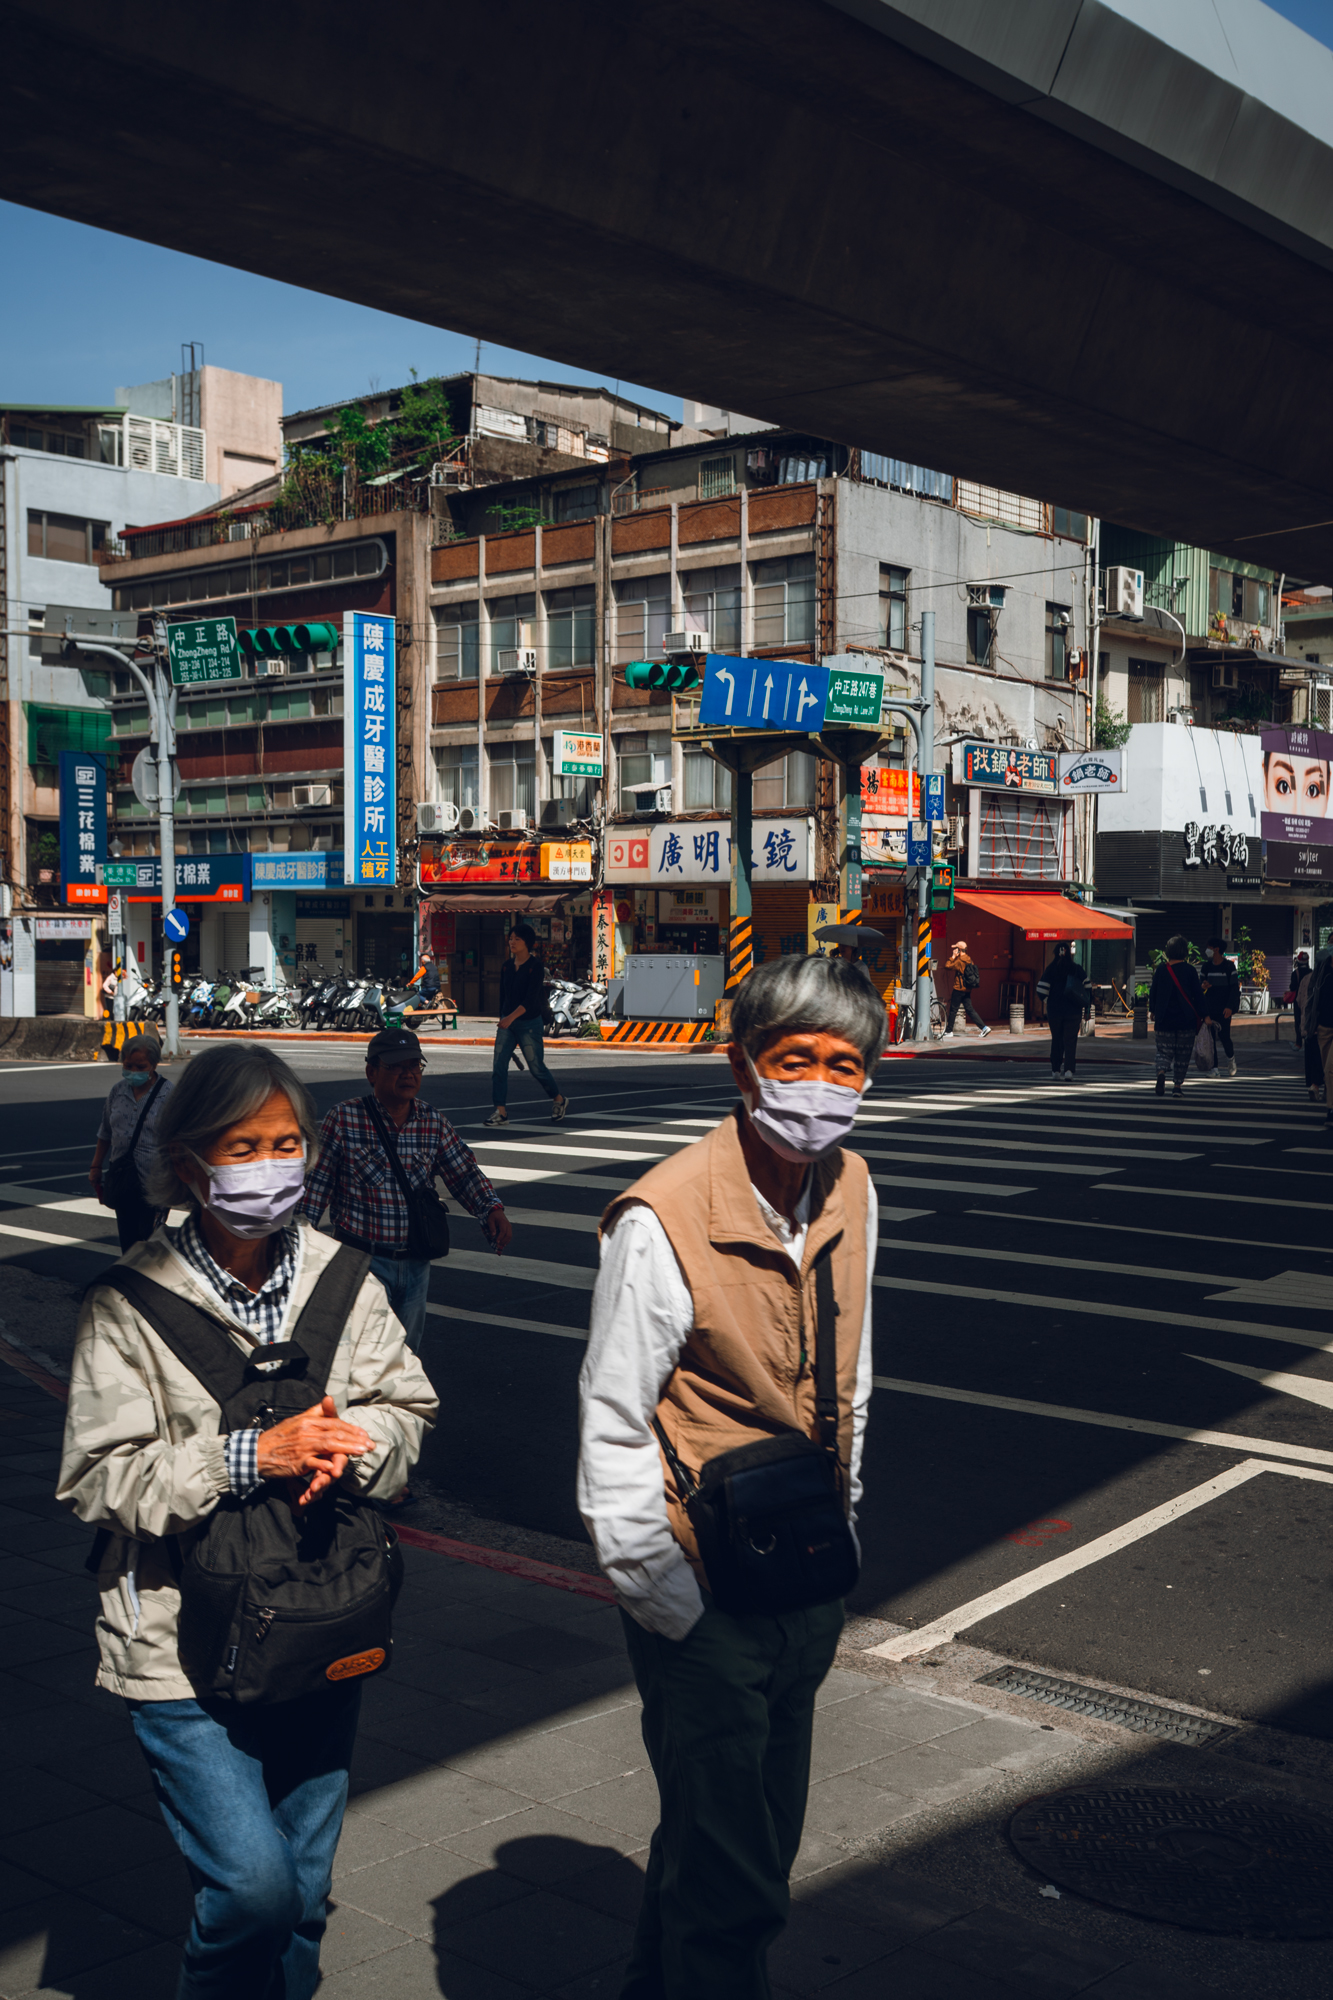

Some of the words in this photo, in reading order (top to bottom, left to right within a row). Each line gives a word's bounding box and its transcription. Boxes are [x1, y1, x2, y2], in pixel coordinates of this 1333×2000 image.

[175, 623, 229, 646] 中正路
[177, 646, 218, 659] ZhongZheng
[834, 677, 877, 699] 中正路247巷
[363, 623, 386, 834] 陳慶成牙醫診所
[973, 747, 1049, 780] 找鍋老師
[1071, 764, 1111, 782] 鍋老師
[78, 788, 96, 874] 三花棉業
[361, 840, 389, 857] 人工
[658, 828, 797, 873] 廣明鏡
[255, 861, 329, 880] 陳慶成牙醫診所
[361, 862, 389, 878] 植牙
[939, 868, 952, 886] 15
[596, 894, 609, 988] 正泰蔘藥行
